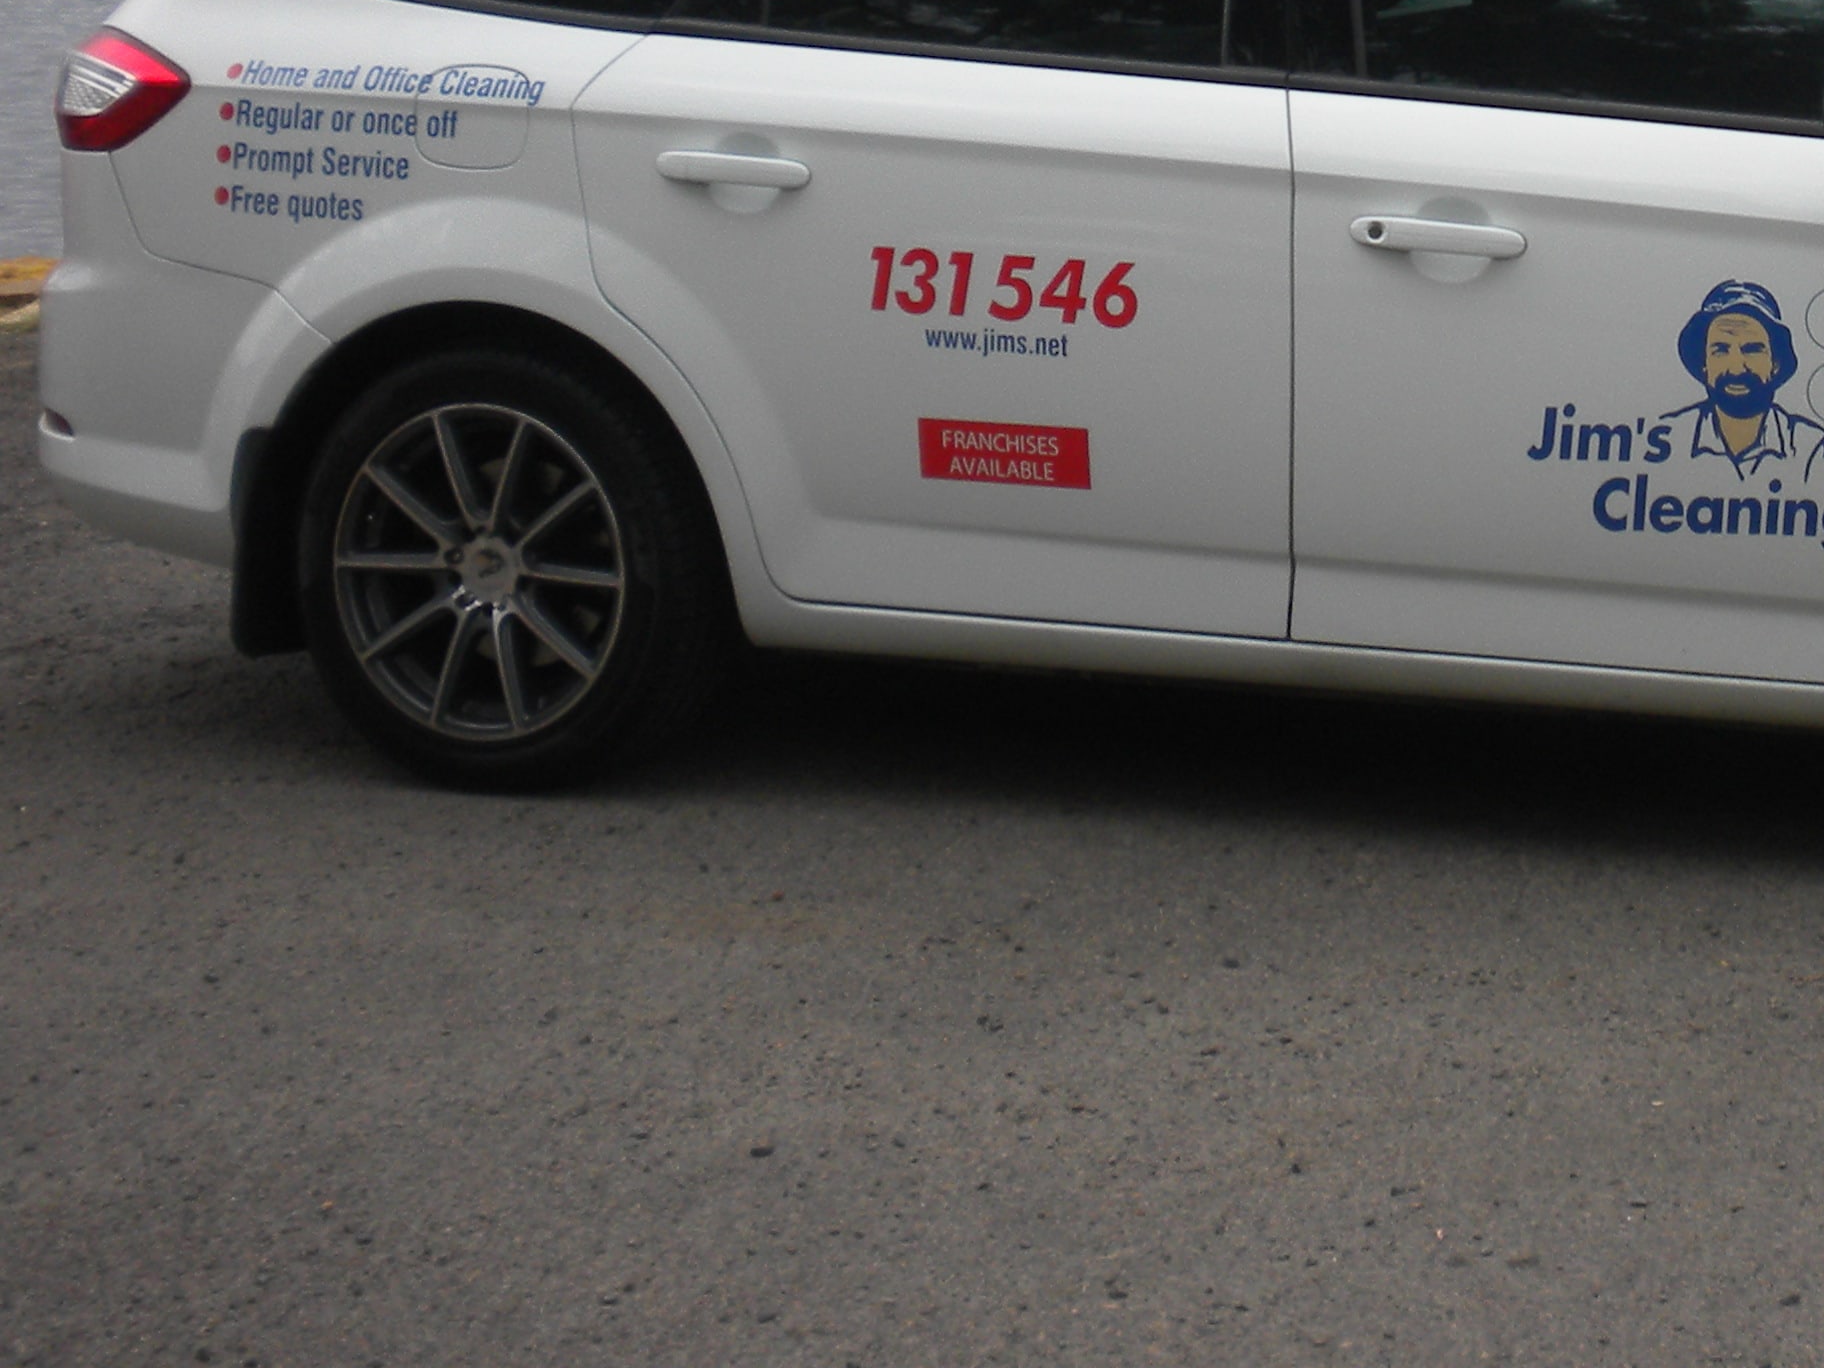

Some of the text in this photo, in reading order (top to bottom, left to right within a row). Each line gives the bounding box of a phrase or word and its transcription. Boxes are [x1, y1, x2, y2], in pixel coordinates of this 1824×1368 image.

[241, 59, 546, 106] Home and Office Cleaning
[235, 100, 458, 138] Regular or once off
[232, 142, 409, 180] Prompt Service
[229, 186, 364, 223] Free quotes
[870, 246, 1138, 329] 131 546
[924, 328, 1069, 357] www.jims.net
[941, 430, 1059, 456] FRANCHISES
[1527, 403, 1672, 462] Jim's
[950, 456, 1055, 481] AVAILABLE
